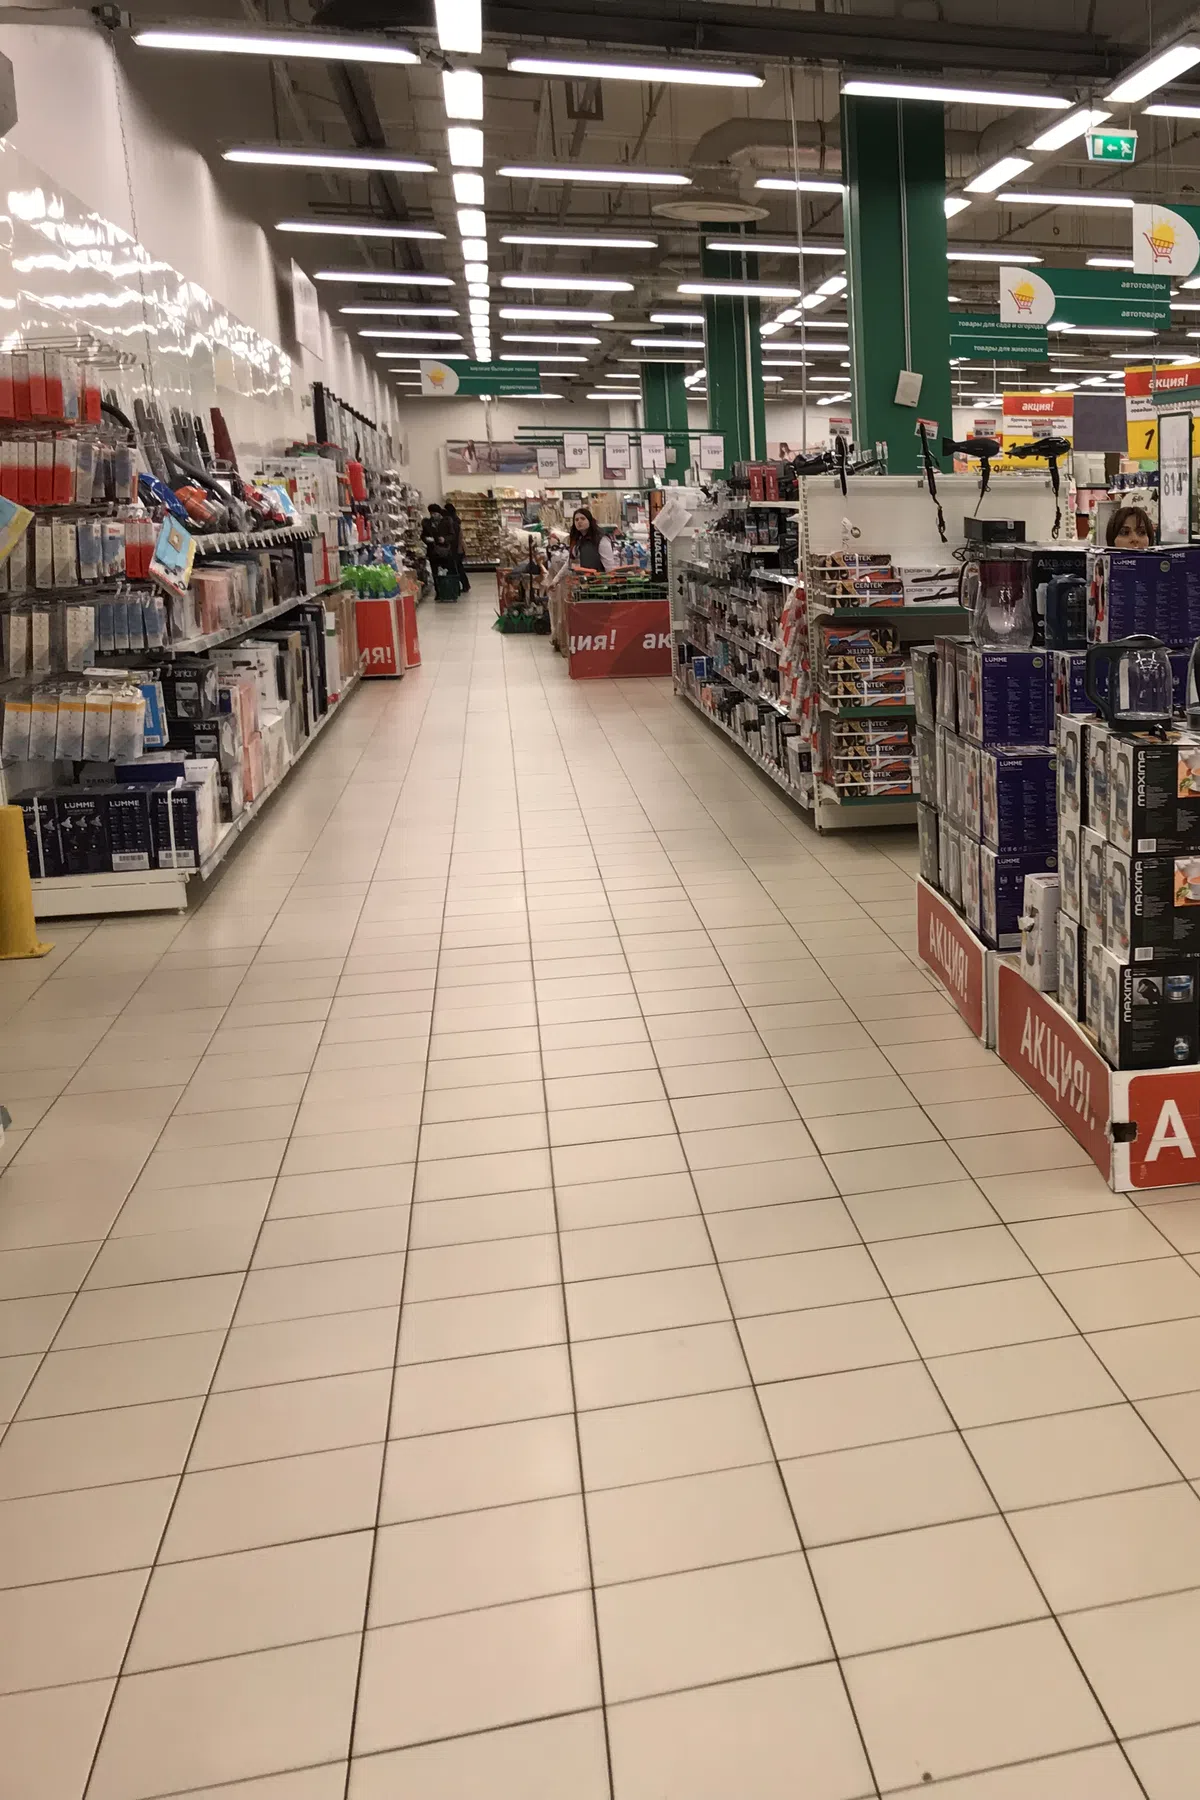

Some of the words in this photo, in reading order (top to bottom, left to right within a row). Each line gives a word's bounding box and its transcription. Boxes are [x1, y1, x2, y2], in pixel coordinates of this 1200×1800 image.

[1121, 281, 1166, 293] автотовары
[1121, 309, 1166, 320] автотовары
[958, 321, 982, 329] товары
[974, 345, 997, 353] товары
[1149, 374, 1189, 389] акция!
[1022, 400, 1054, 412] акция!
[1163, 473, 1183, 496] 814
[654, 527, 664, 575] URACELL
[1137, 750, 1146, 807] MAXIMA
[22, 804, 48, 812] UMME
[64, 801, 95, 809] LUMME
[109, 800, 140, 808] LUMME
[1134, 861, 1143, 916] MAXIMA
[929, 911, 969, 1003] АКЦИЯ!
[1123, 968, 1132, 1023] MAXIMA
[1020, 1007, 1095, 1131] АКЦИЯ!
